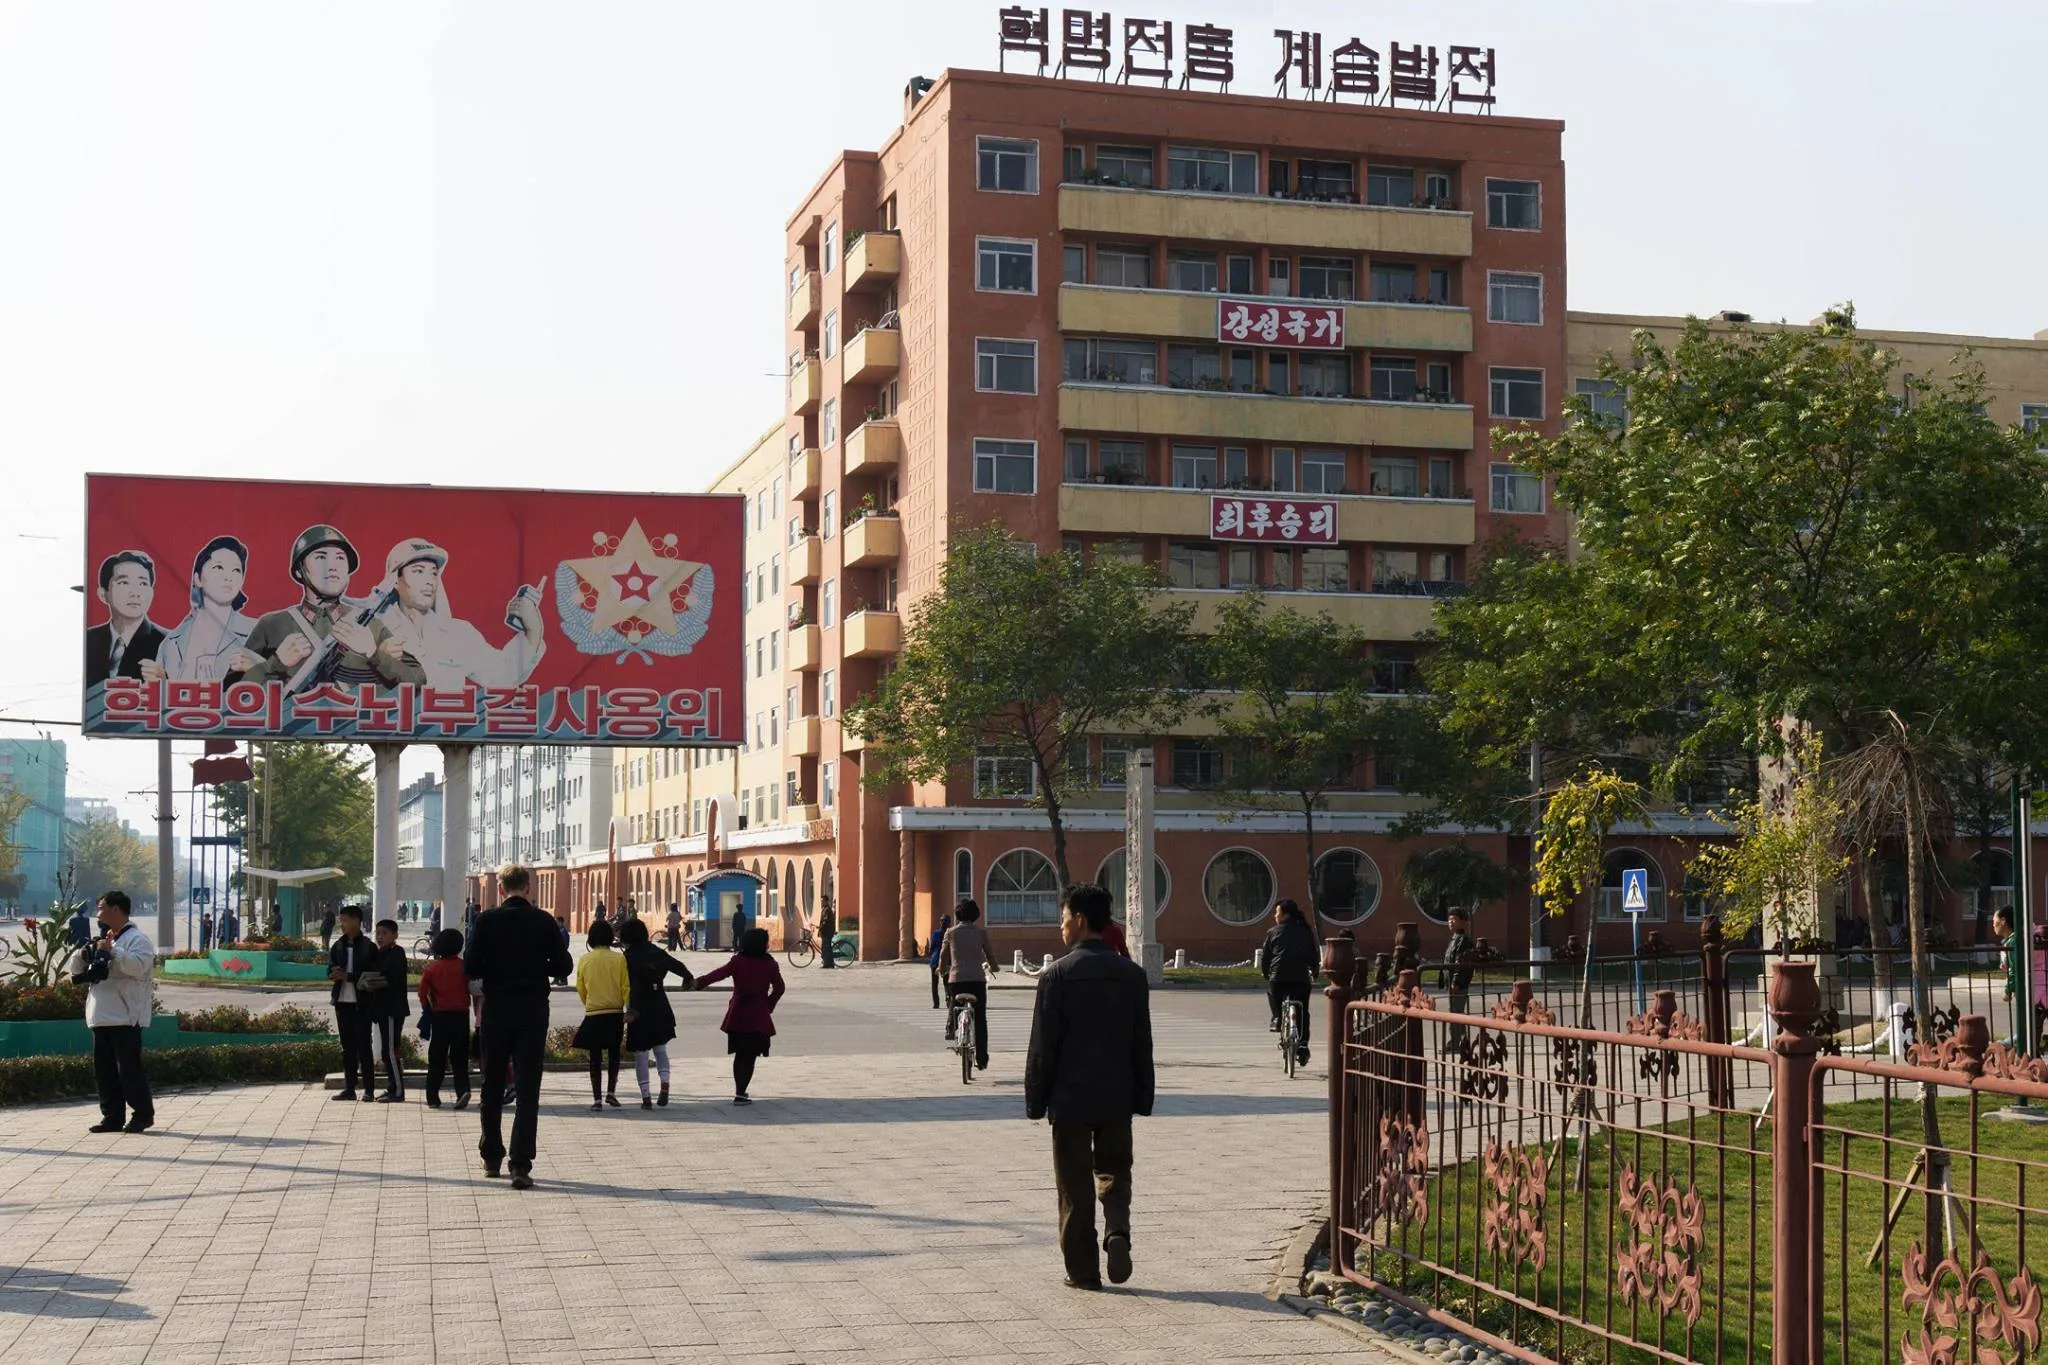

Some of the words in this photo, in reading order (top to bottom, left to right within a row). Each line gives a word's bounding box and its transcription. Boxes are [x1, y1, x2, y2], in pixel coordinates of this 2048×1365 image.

[999, 5, 1234, 83] 혁명전통
[1274, 29, 1496, 104] 계승발전
[1222, 305, 1341, 345] 강성국가
[1215, 501, 1333, 540] 최후승리
